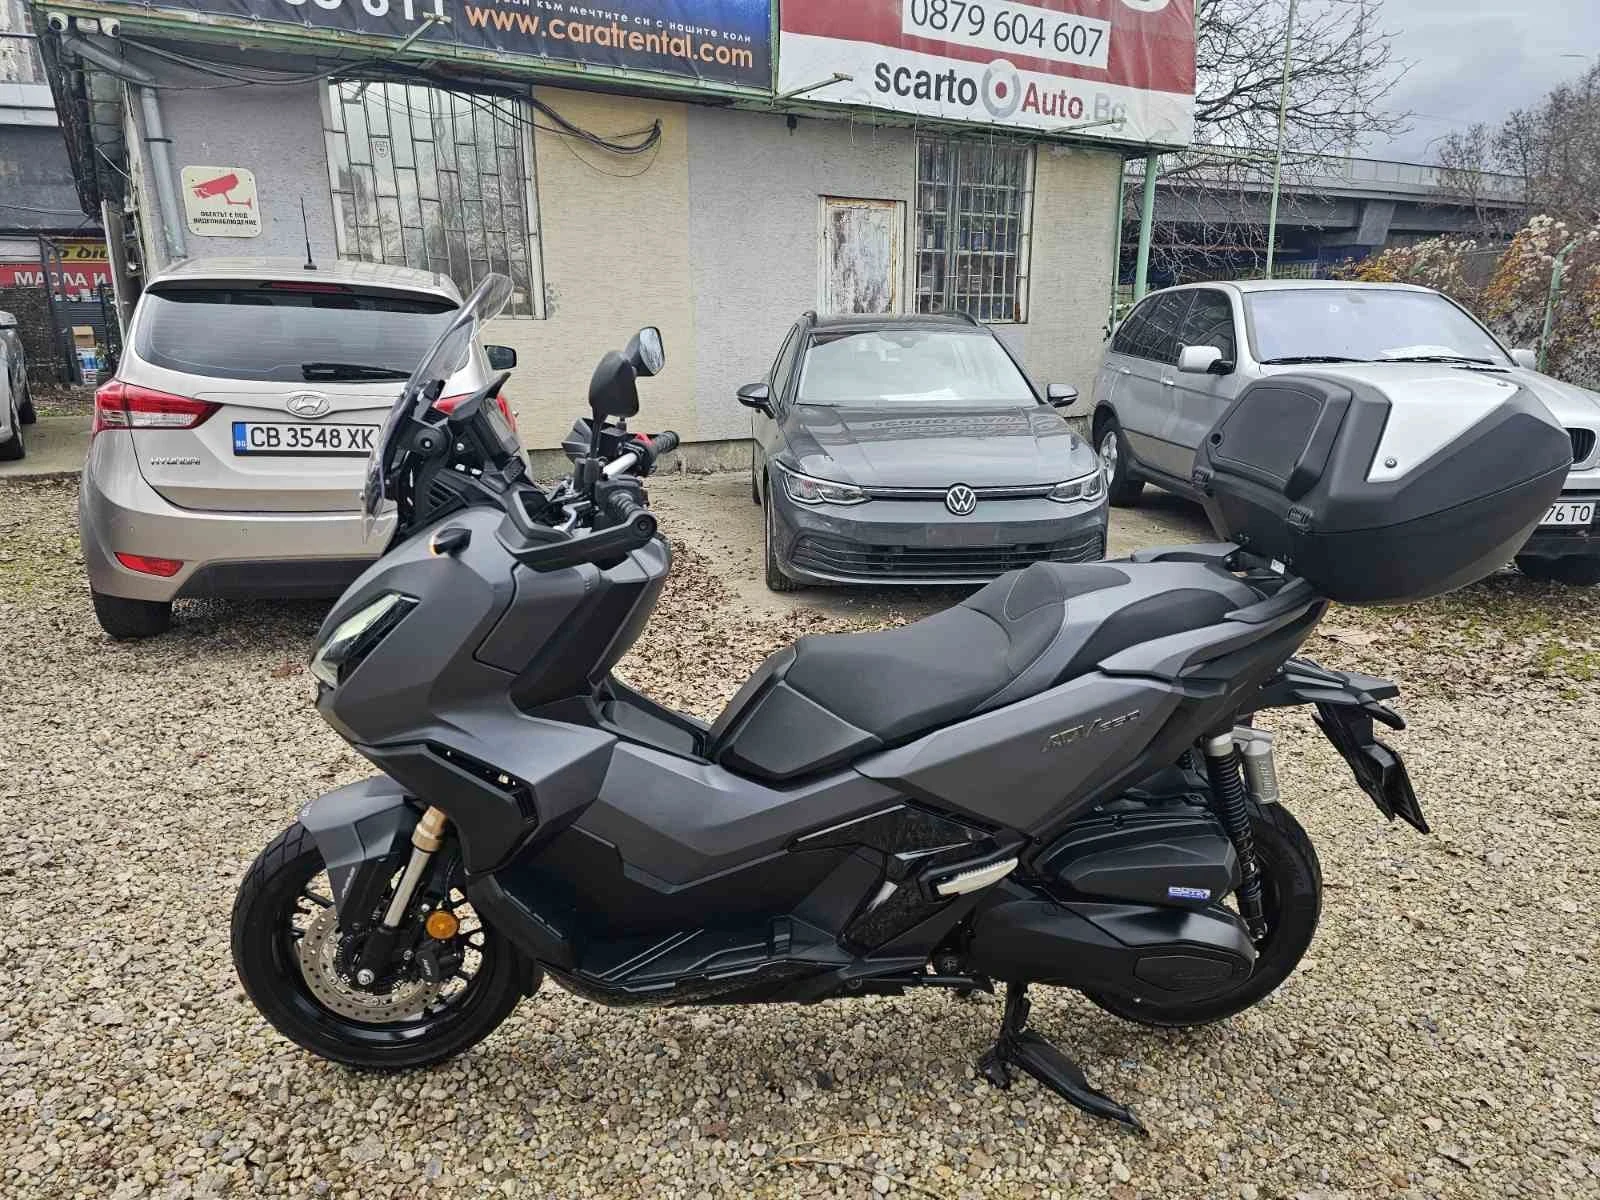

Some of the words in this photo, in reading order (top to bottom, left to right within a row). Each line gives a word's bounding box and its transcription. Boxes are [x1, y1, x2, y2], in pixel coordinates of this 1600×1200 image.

[464, 5, 753, 68] www.caratrental.com
[537, 1, 563, 12] към
[569, 6, 629, 23] мечтите
[634, 15, 651, 26] си
[669, 21, 718, 38] нашите
[723, 31, 751, 43] коли
[910, 0, 985, 36] 0879
[993, 11, 1046, 48] 604
[1053, 22, 1103, 57] 607
[874, 62, 978, 106] scarto
[250, 427, 281, 448] CB
[286, 427, 342, 449] 3548
[347, 429, 375, 449] XK
